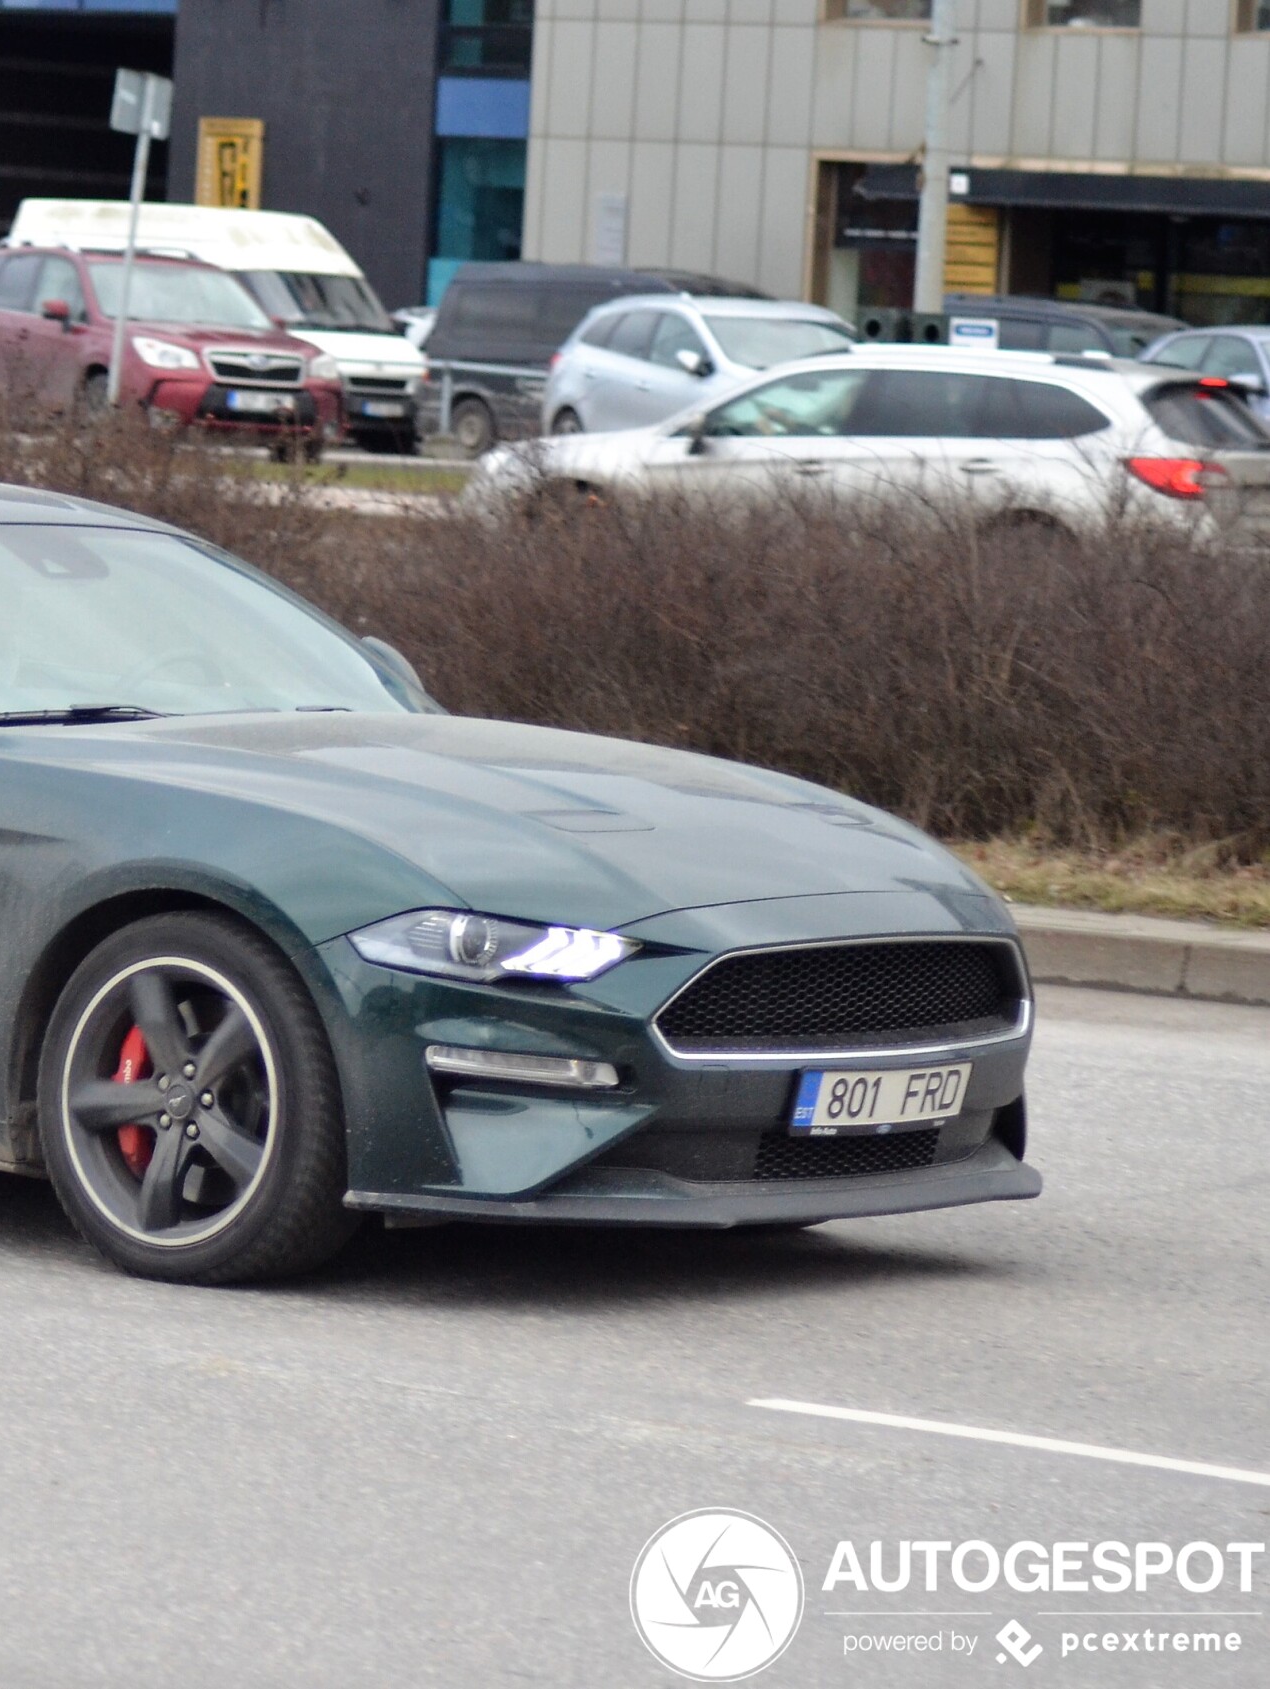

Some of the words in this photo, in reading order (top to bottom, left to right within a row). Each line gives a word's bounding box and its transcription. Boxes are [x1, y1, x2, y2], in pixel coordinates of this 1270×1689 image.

[827, 1077, 882, 1119] 801
[900, 1069, 962, 1115] FRD
[794, 1107, 815, 1119] EST
